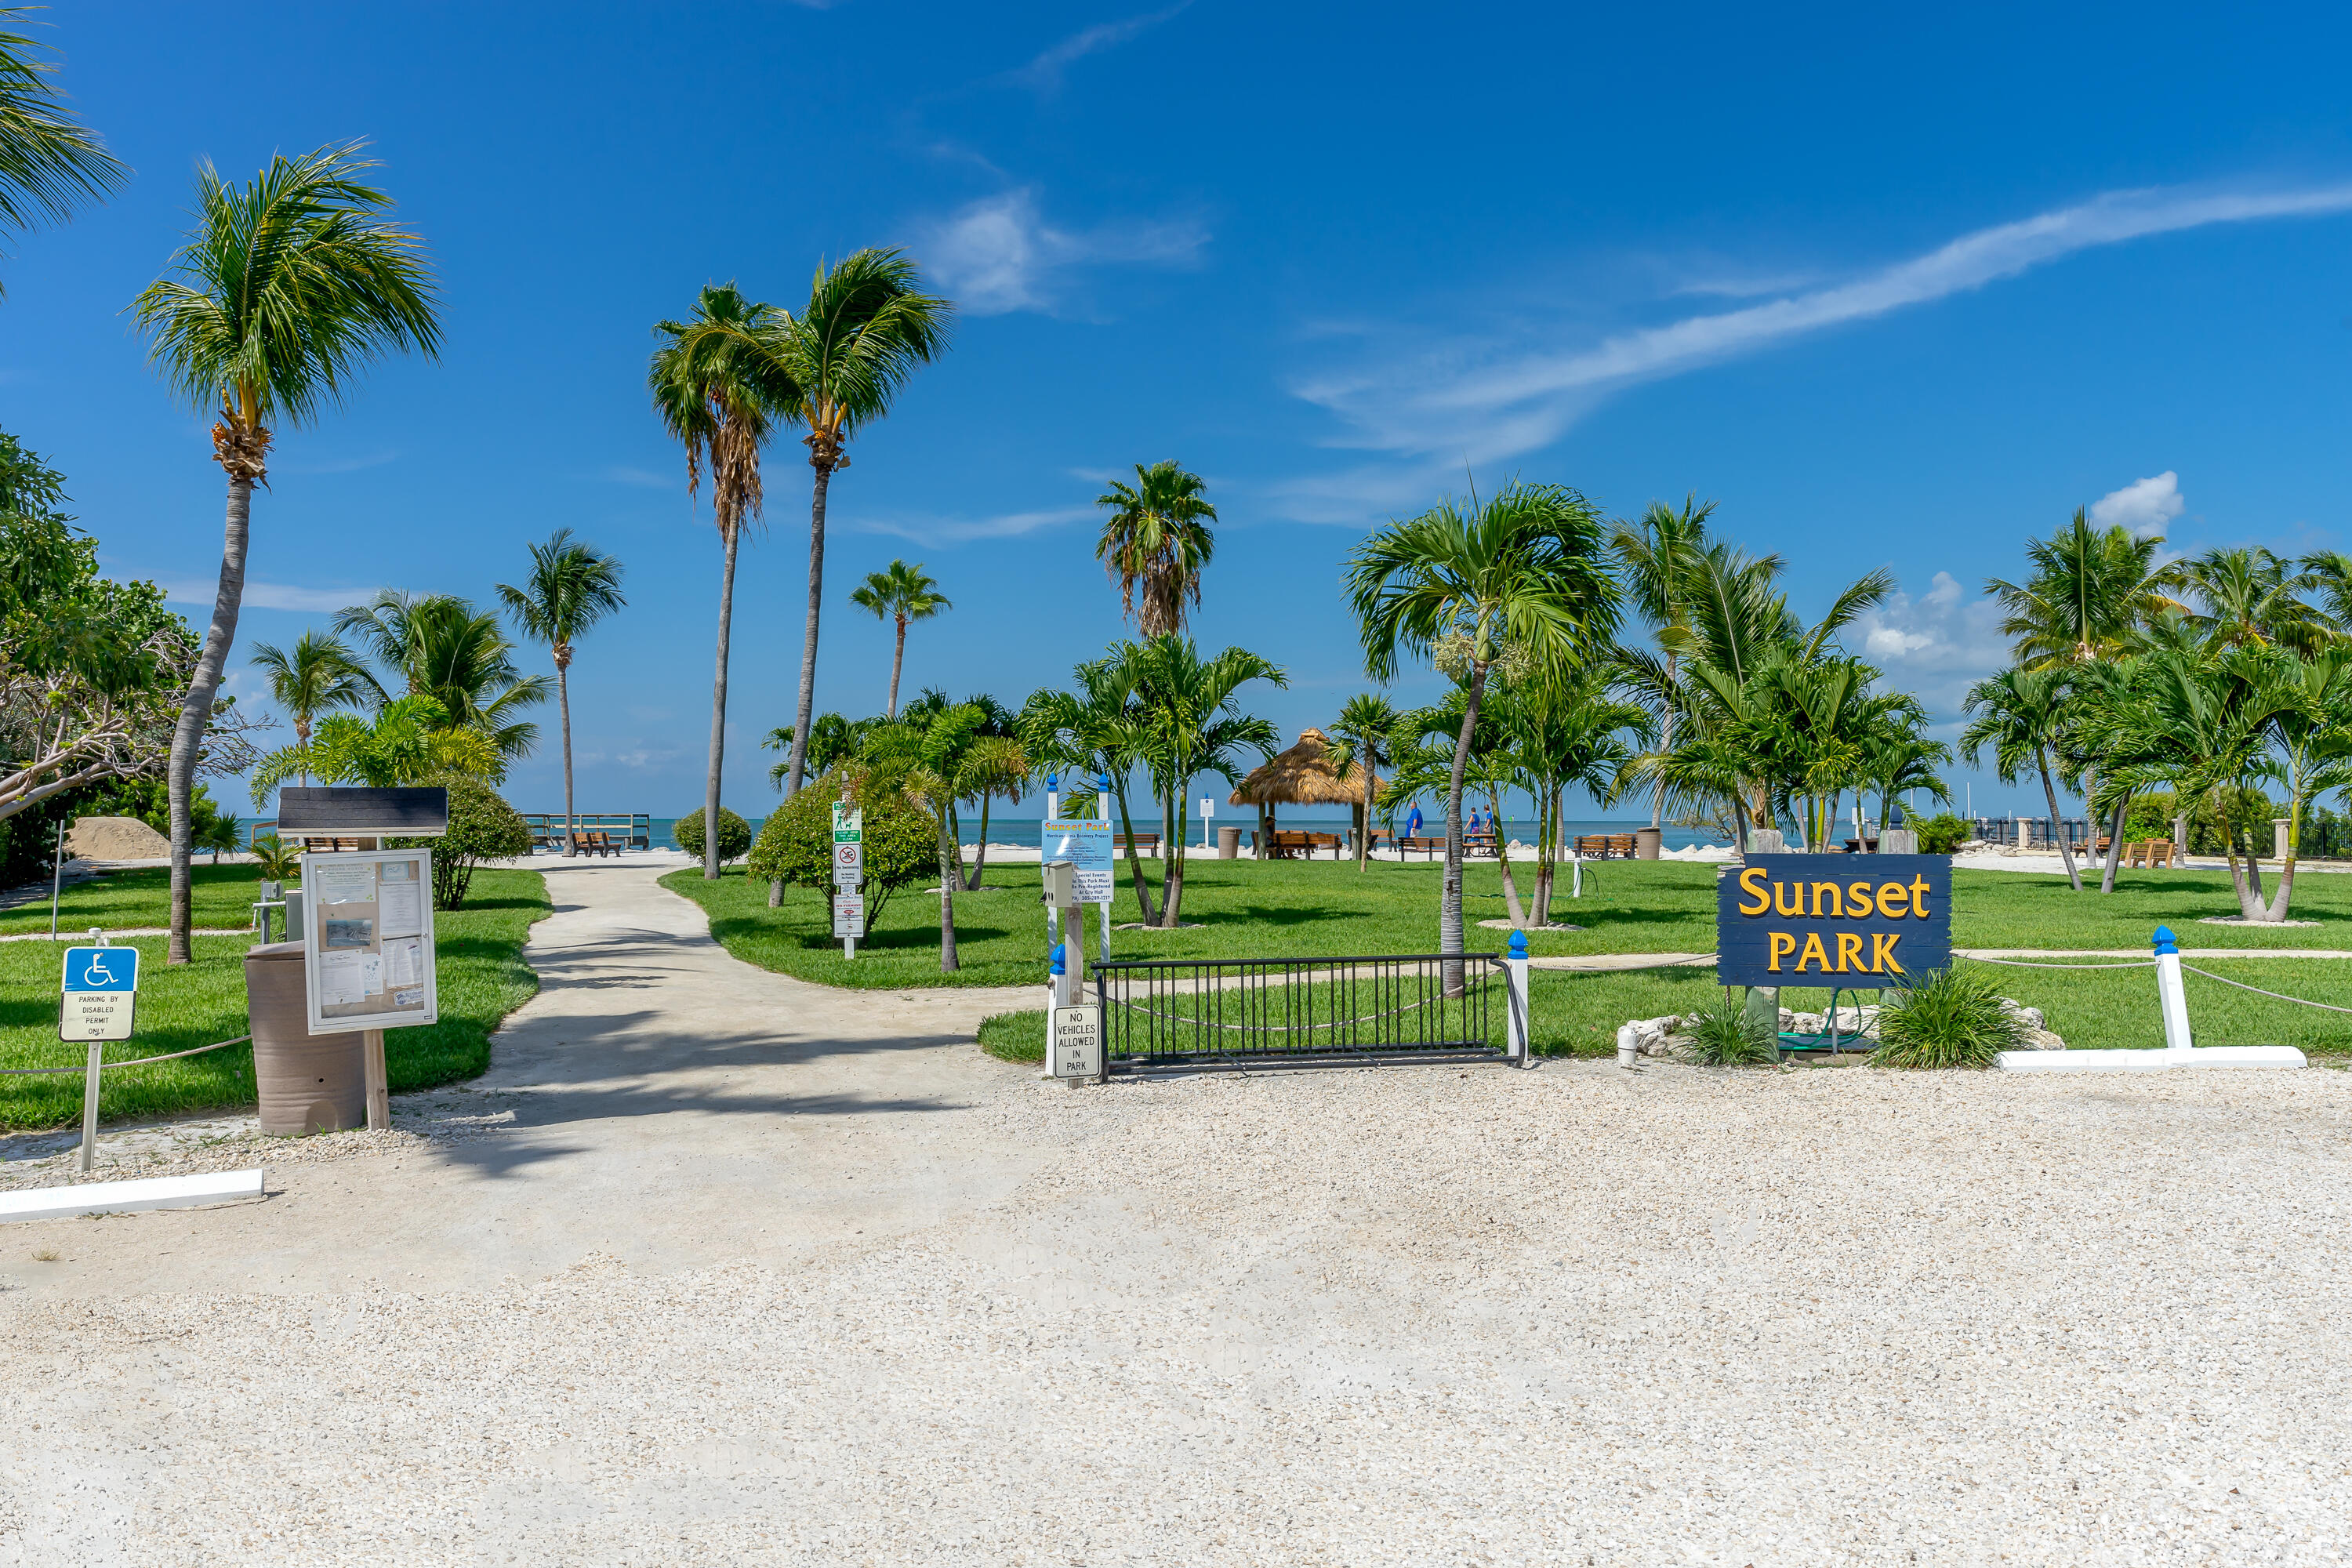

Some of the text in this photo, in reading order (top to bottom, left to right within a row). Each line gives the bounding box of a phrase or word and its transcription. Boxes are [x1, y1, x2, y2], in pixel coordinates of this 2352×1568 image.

[1045, 822, 1110, 831] Sunset Park
[1738, 867, 1931, 918] Sunset
[1767, 932, 1905, 974] PARK
[1069, 1013, 1083, 1022] NO
[1058, 1024, 1095, 1035] VEHICLES
[1058, 1036, 1094, 1047] ALLOWED
[1073, 1049, 1080, 1058] IN
[1066, 1061, 1087, 1071] PARK
